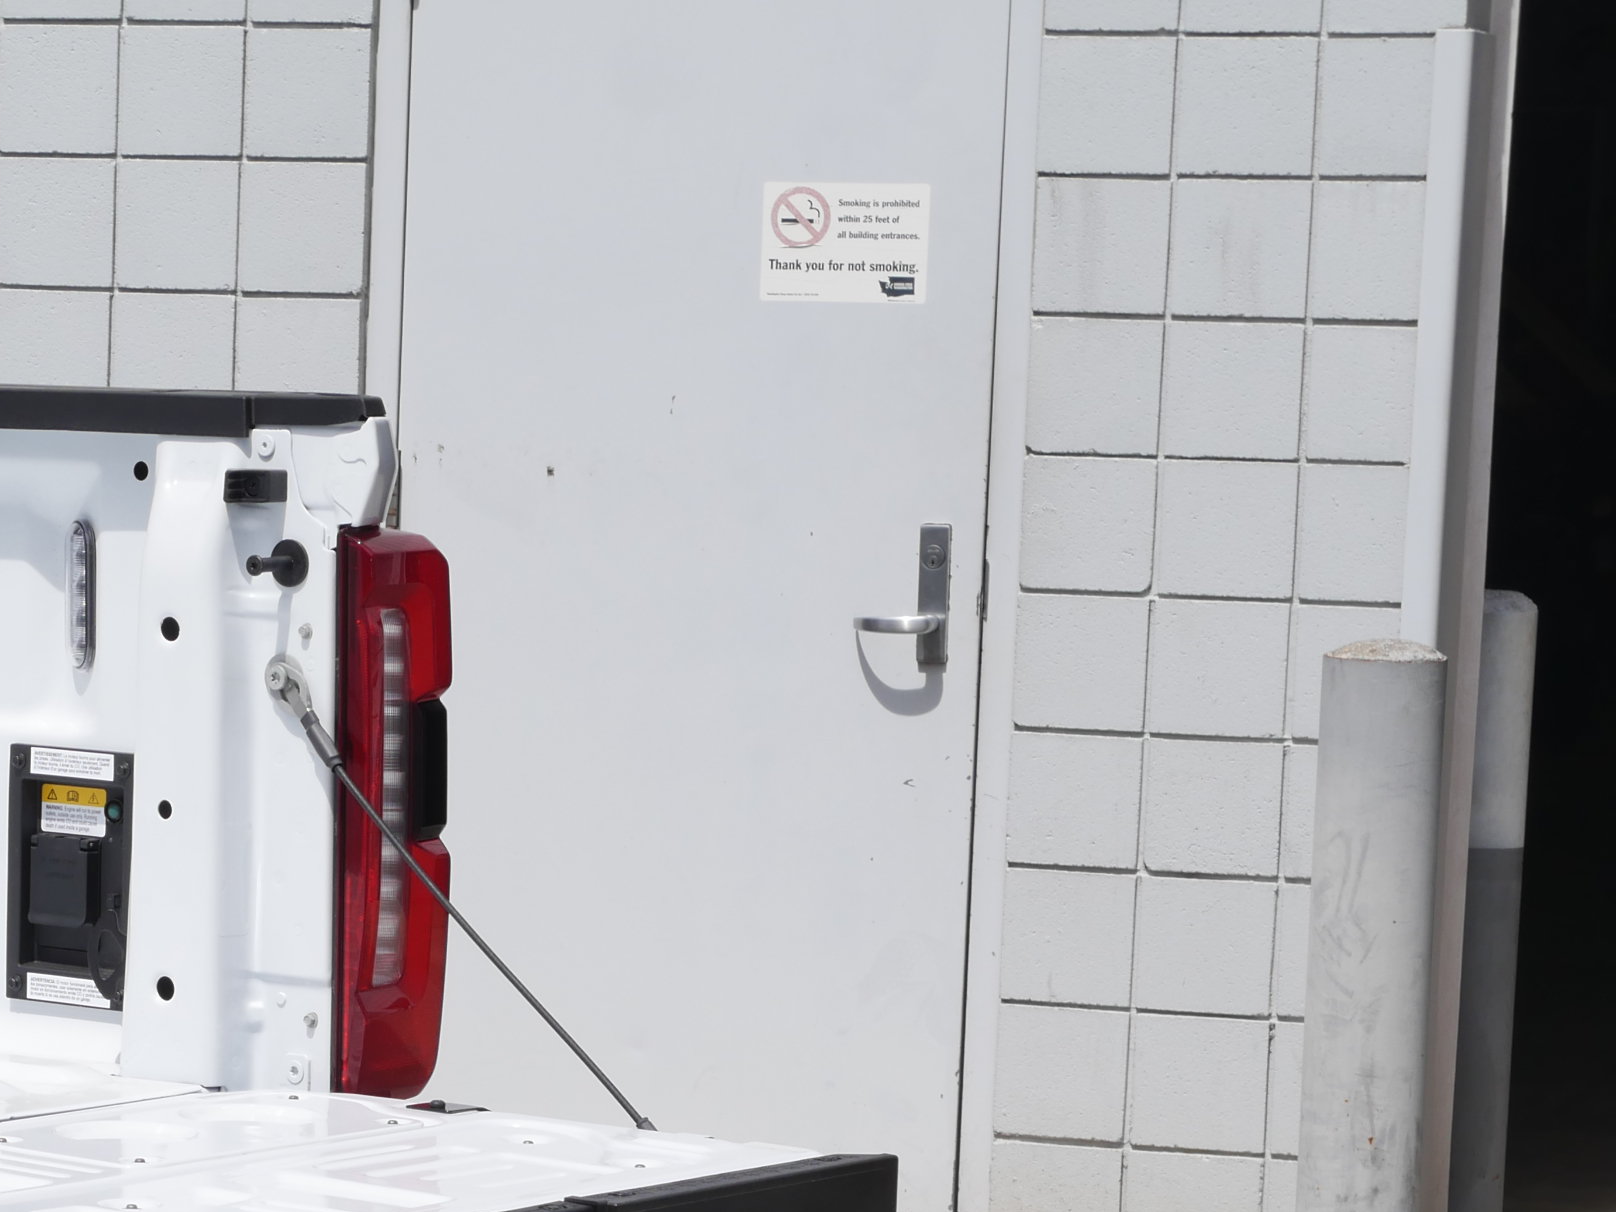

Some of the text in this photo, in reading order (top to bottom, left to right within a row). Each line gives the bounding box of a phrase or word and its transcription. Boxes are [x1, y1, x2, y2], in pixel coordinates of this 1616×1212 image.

[838, 198, 920, 208] Smoking is prohibited
[838, 215, 860, 223] within
[863, 215, 873, 223] 25
[837, 230, 920, 240] all building entrances.
[768, 258, 919, 275] Thank you for not smoking.
